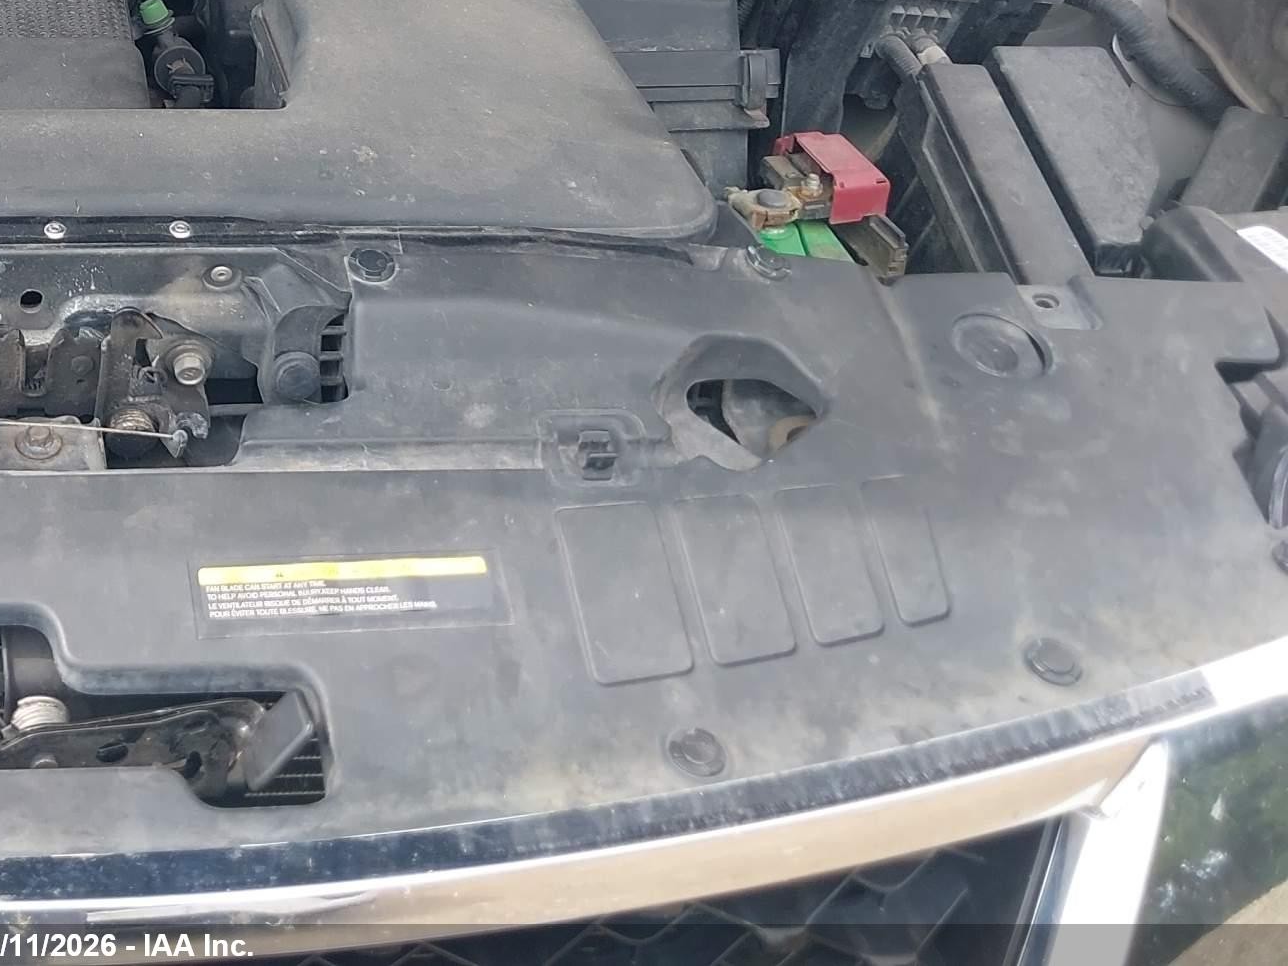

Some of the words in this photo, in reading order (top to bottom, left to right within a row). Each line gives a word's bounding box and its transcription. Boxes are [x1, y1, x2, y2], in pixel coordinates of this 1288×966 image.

[206, 585, 220, 593] FAN
[221, 584, 244, 592] BLADE
[260, 583, 283, 591] START
[294, 582, 308, 590] ANY
[207, 593, 217, 601] TO
[218, 592, 237, 601] HELP
[238, 591, 259, 600] AVOID
[260, 590, 297, 599] PERSONAL
[340, 587, 365, 595] HANDS
[209, 610, 230, 618] POUR
[256, 608, 279, 616] TOUTE
[355, 602, 399, 611] APPROCHER
[400, 601, 413, 609] LES
[218, 601, 264, 610] VENTILATEUR
[291, 599, 302, 607] DE
[348, 595, 366, 603] TOUT
